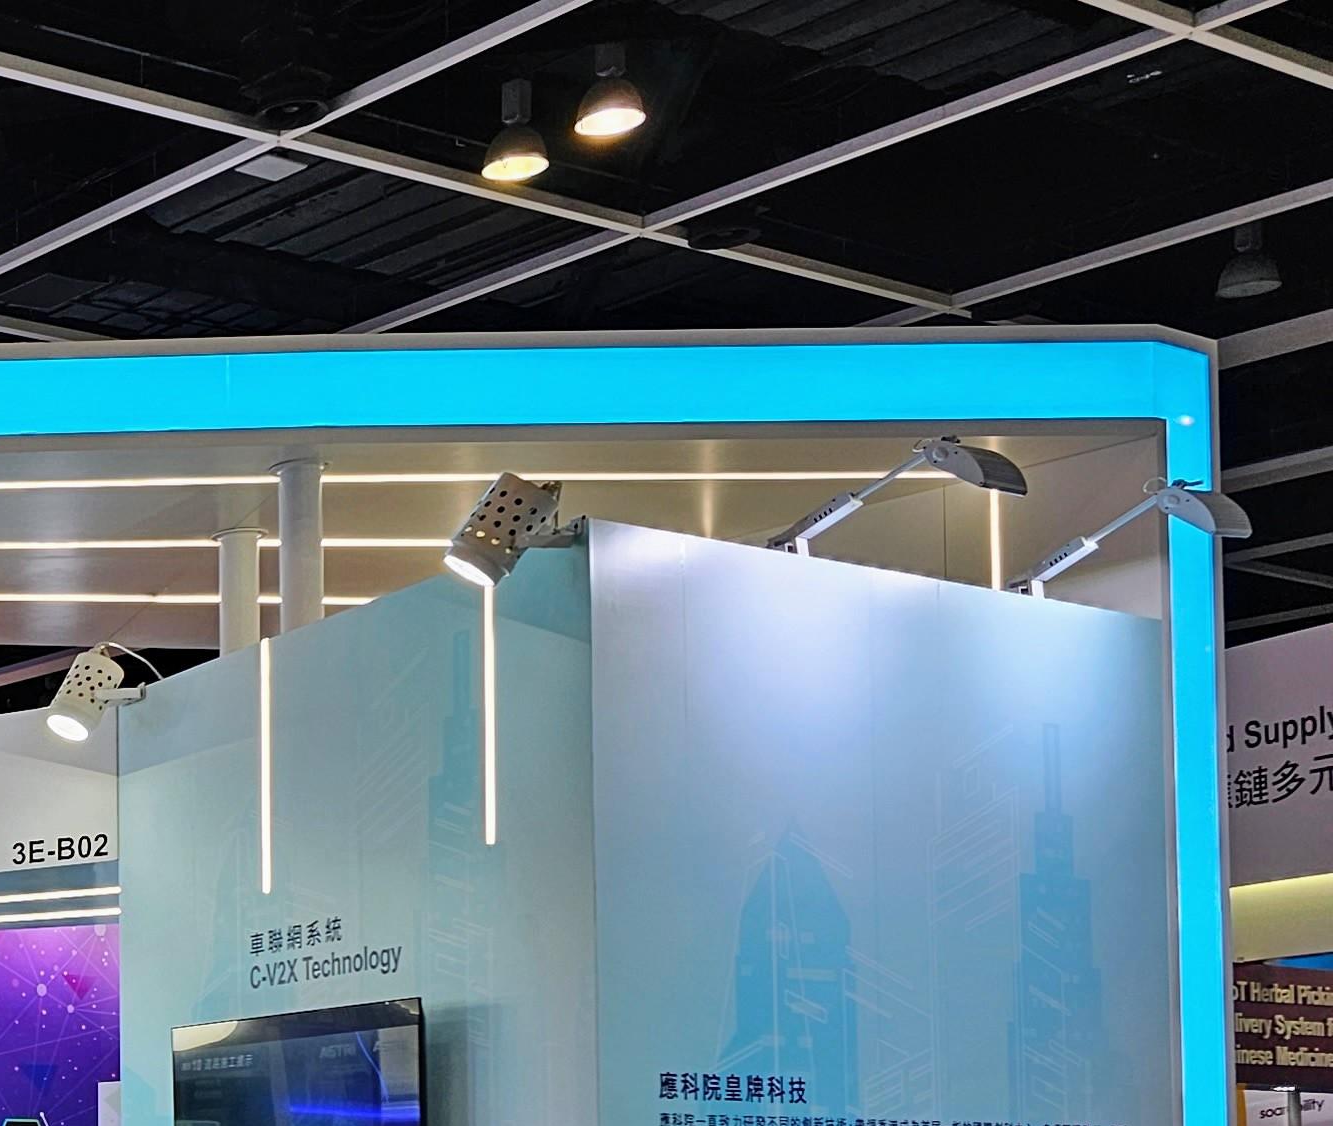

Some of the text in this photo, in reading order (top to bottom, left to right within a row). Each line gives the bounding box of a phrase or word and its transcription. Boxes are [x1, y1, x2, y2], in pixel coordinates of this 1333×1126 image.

[1227, 753, 1333, 809] 鏈多元
[11, 833, 109, 866] 3E-B02
[249, 916, 342, 957] 車聯網系統
[250, 945, 402, 989] C-V2X Technology
[1232, 980, 1248, 1001] oT
[1250, 981, 1295, 1004] Herbal
[1234, 1012, 1272, 1039] livery
[1274, 1014, 1325, 1040] System
[1236, 1044, 1274, 1065] inese
[659, 1071, 807, 1104] 應科院皇牌科技
